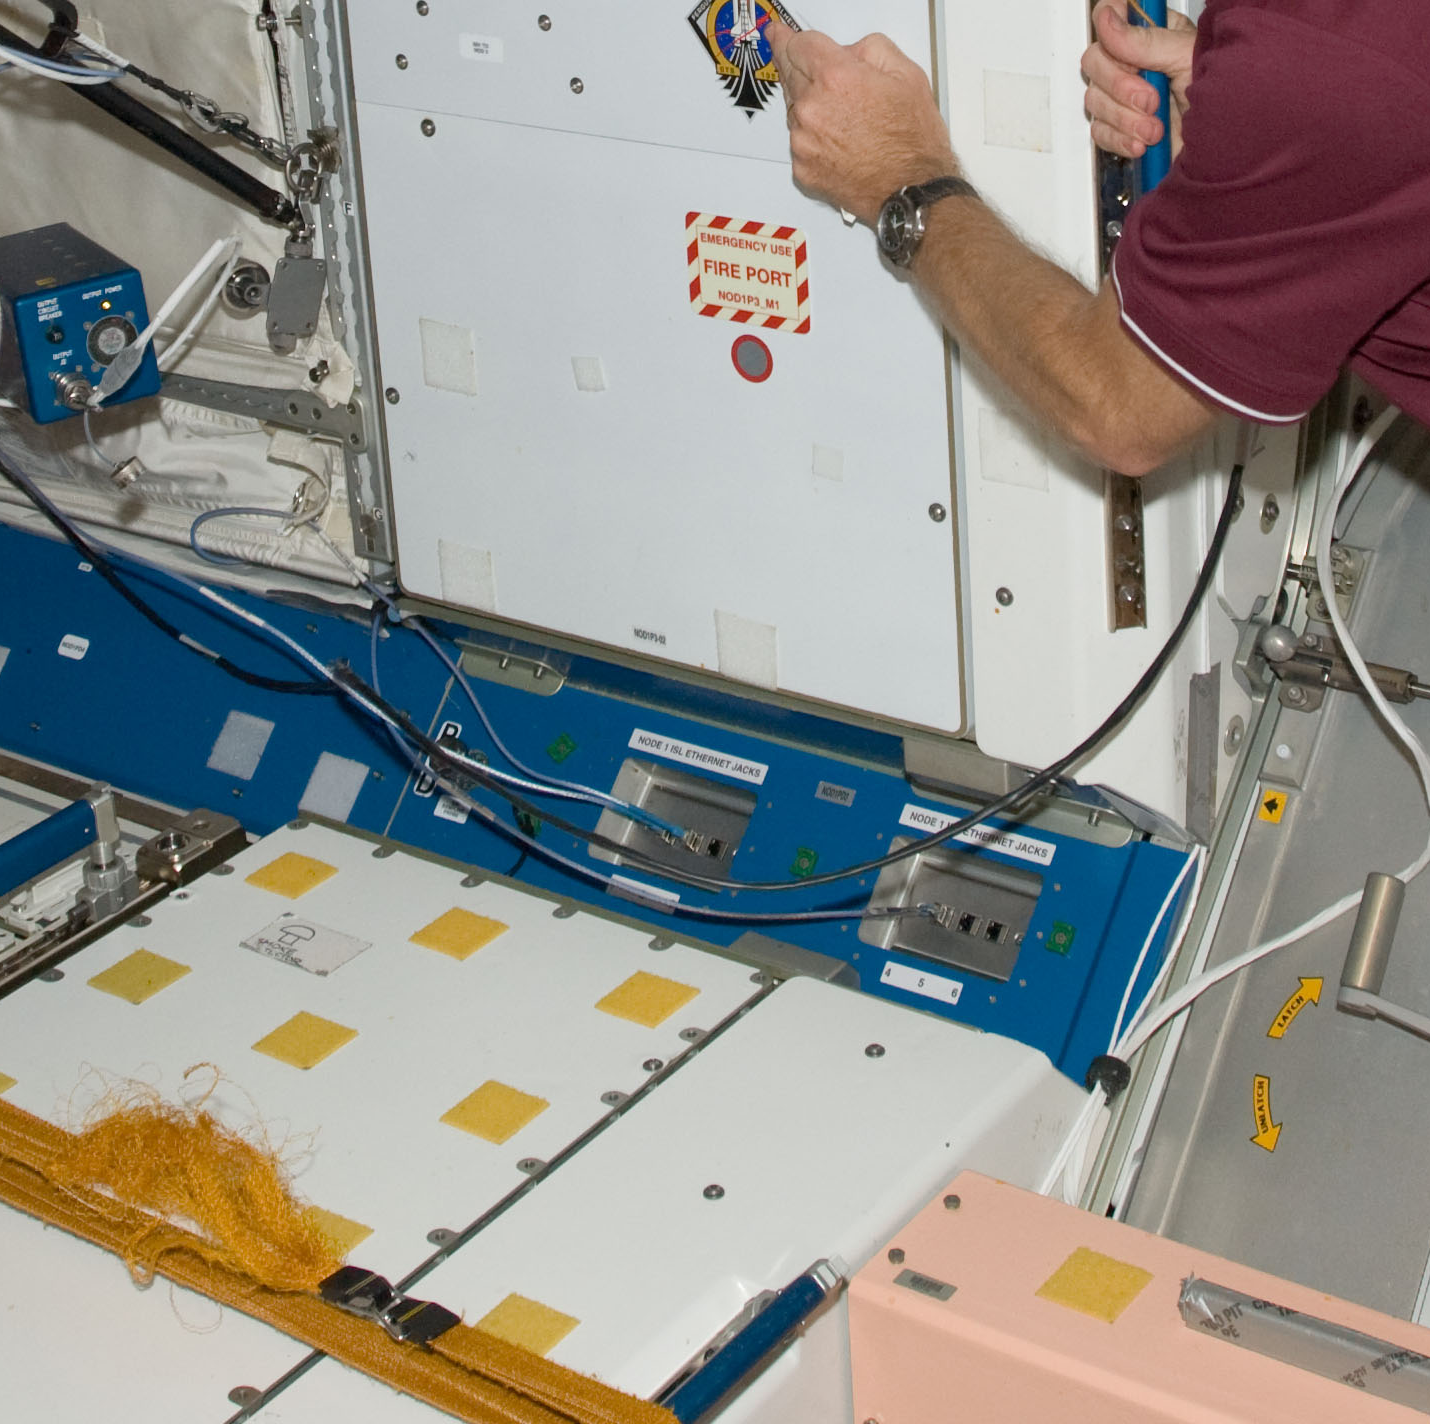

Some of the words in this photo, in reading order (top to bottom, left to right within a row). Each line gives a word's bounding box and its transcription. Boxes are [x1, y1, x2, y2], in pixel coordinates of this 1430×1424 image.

[700, 232, 767, 253] EMERGENCY
[771, 244, 792, 257] USE
[704, 259, 741, 279] FIRE
[746, 266, 792, 287] PORT
[718, 290, 779, 310] NOD1P3_M1
[633, 628, 666, 646] NOD1P3-02
[638, 735, 662, 750] NODE
[670, 744, 684, 756] ISL
[685, 749, 731, 770] ETHERNET
[732, 762, 761, 777] JACKS
[910, 811, 936, 826] NODE
[1015, 839, 1049, 857] JACKS
[885, 968, 891, 977] 4
[918, 978, 925, 987] 5
[951, 988, 958, 998] 6
[1277, 995, 1304, 1028] LATCH
[1258, 1080, 1269, 1134] UNLATCH
